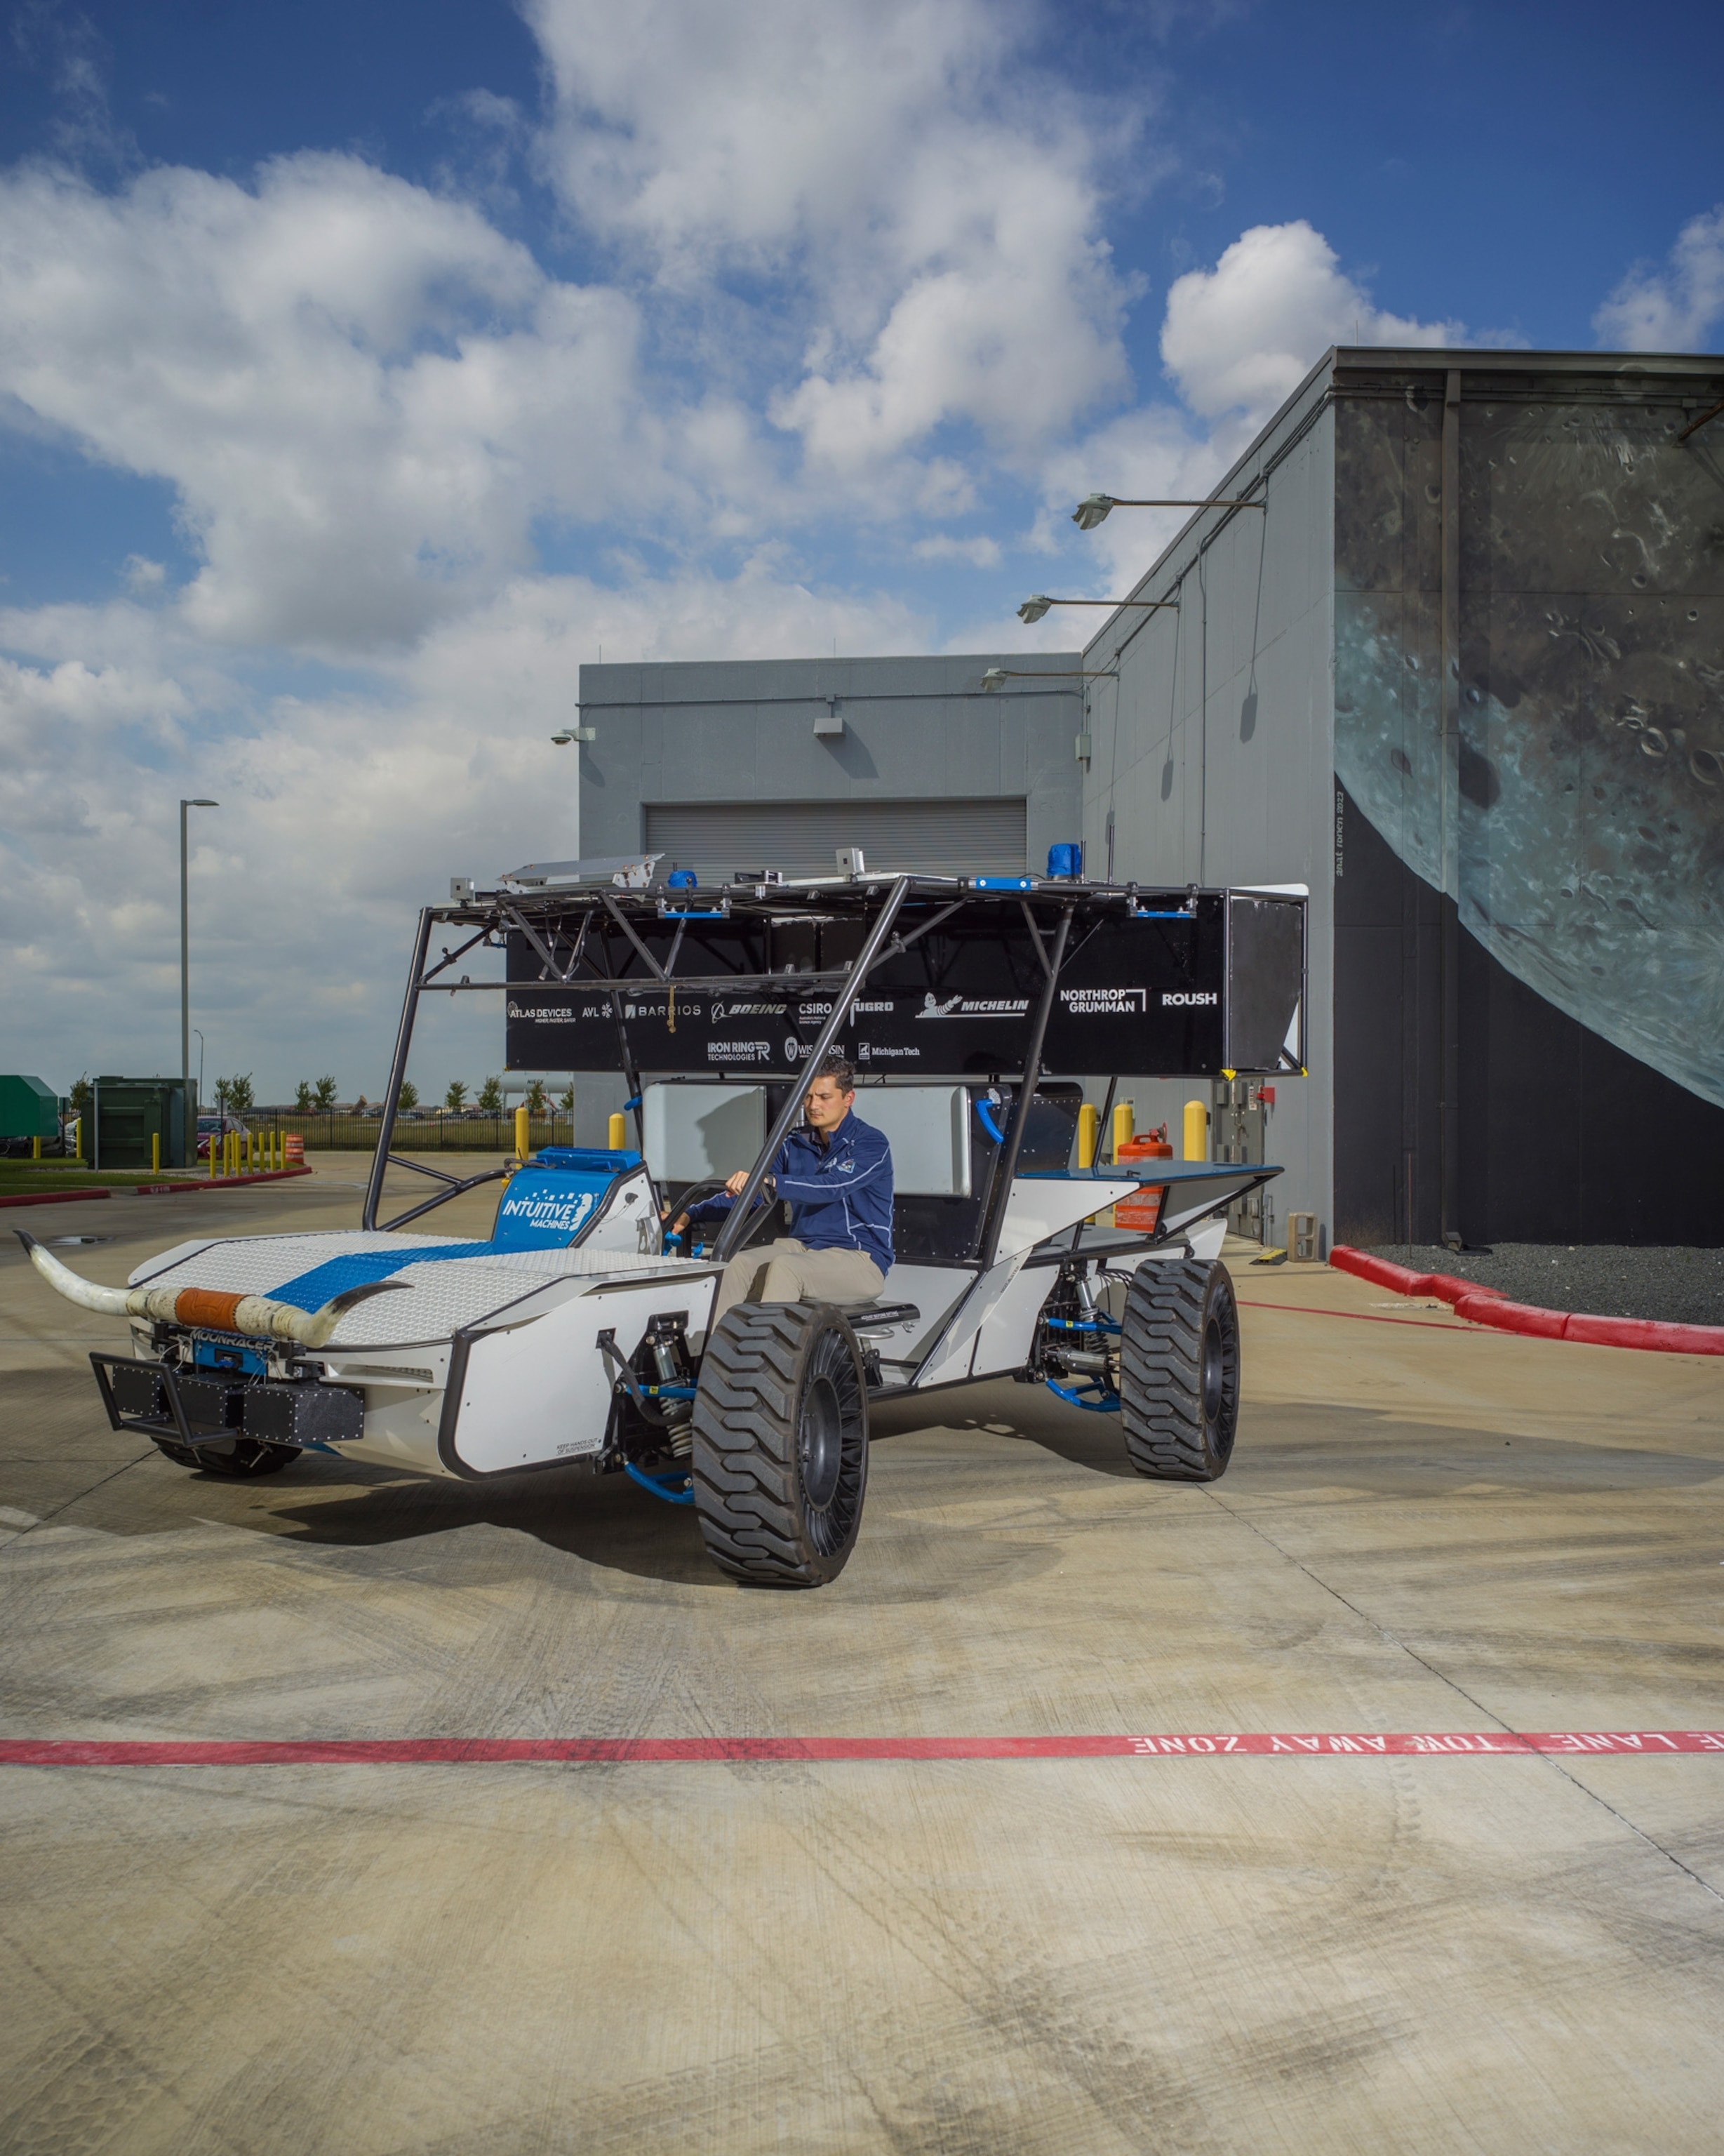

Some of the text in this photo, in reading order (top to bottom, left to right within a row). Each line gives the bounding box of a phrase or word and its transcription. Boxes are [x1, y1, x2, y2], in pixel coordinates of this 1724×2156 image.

[1336, 791, 1344, 813] 2022
[1335, 851, 1344, 877] anat
[1060, 989, 1126, 1001] NORTHROP
[1162, 993, 1217, 1005] ROUSH
[729, 1004, 787, 1015] BOEING
[798, 1003, 832, 1014] CSIRO
[961, 999, 1029, 1011] MICHELIN
[1069, 1001, 1135, 1012] GRUMMAN
[510, 1008, 572, 1018] ATLAS DEVICES
[582, 1007, 599, 1017] AVL
[707, 1042, 755, 1053] IRON RING
[798, 1045, 845, 1055] WISSIN
[871, 1047, 921, 1057] Michigan Tech
[502, 1199, 575, 1220] INTUITIVE
[530, 1219, 570, 1230] MACHINES
[190, 1328, 276, 1351] MOONRACER
[1128, 1736, 1248, 1752] ZONE
[1270, 1736, 1386, 1751] AWAY
[1409, 1735, 1502, 1752] TOW
[1549, 1734, 1679, 1750] LANE
